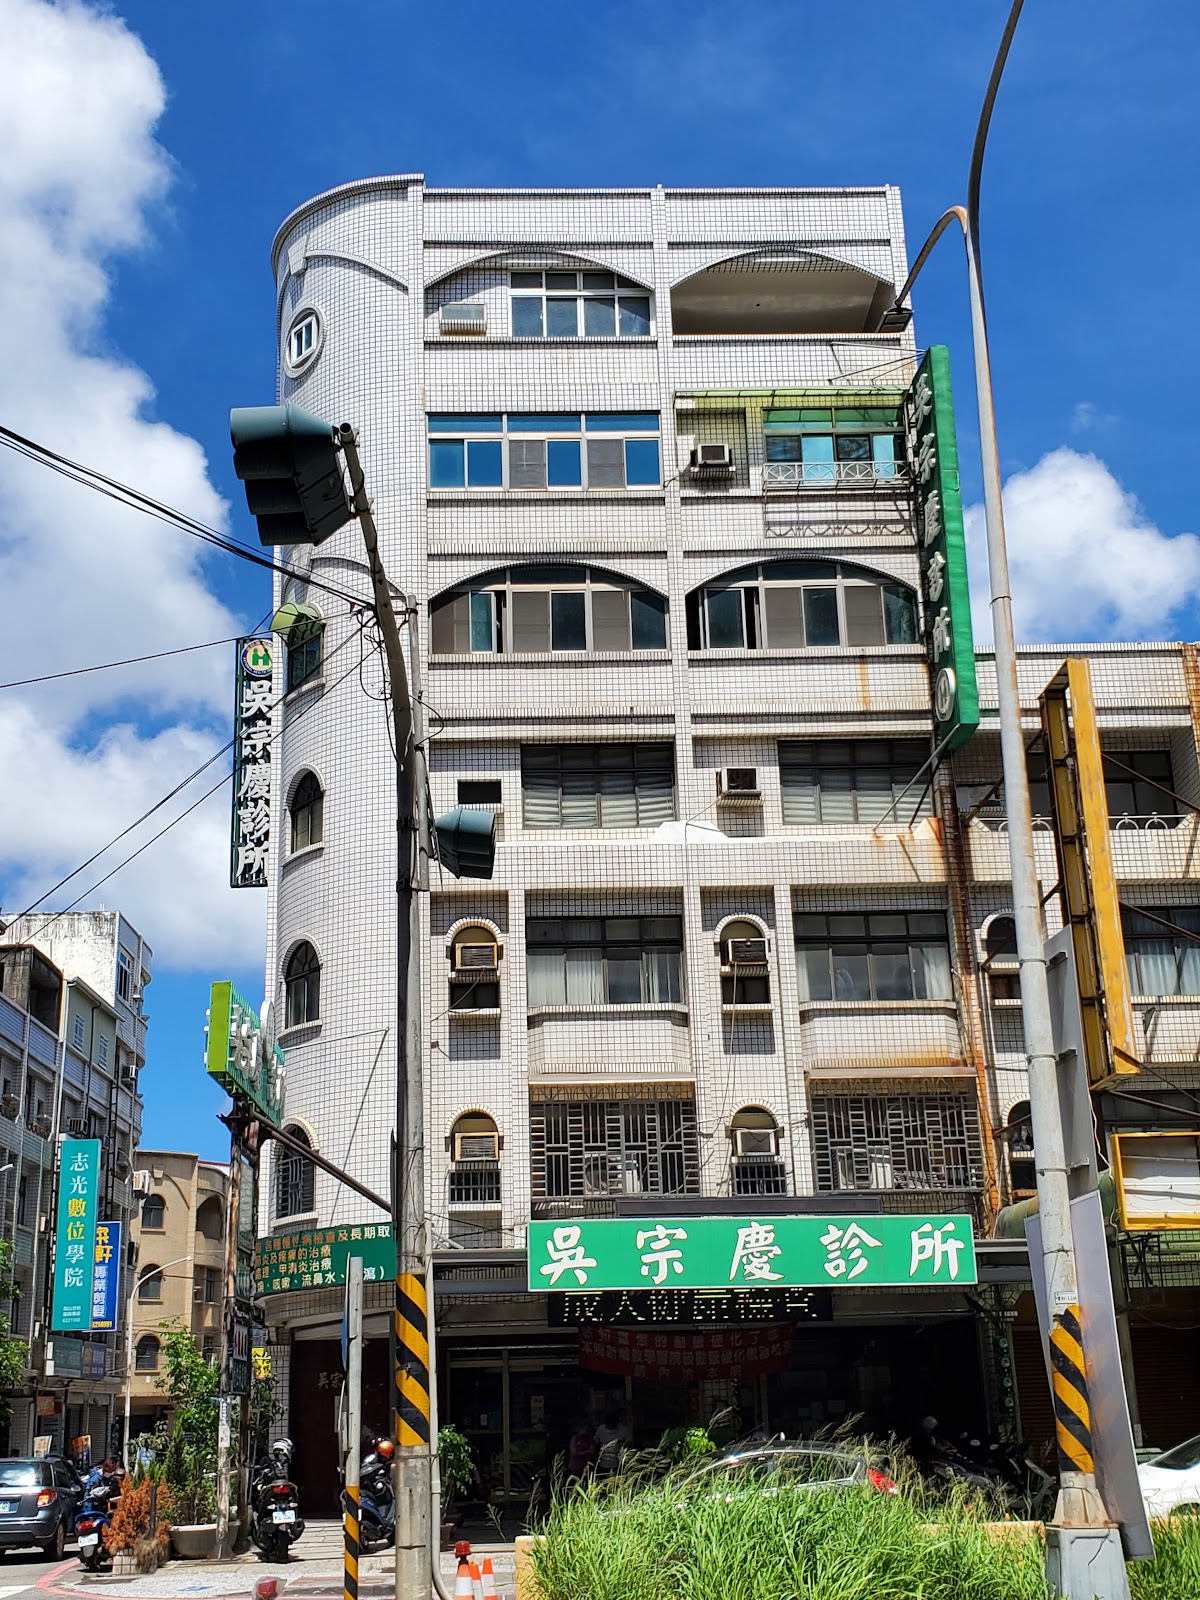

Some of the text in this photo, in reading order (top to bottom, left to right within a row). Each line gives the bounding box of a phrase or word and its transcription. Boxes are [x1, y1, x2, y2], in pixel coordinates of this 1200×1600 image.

[237, 680, 272, 878] 吳宗慶診所
[64, 1153, 89, 1288] 志光數位學院
[539, 1221, 964, 1285] 吳宗慶診所
